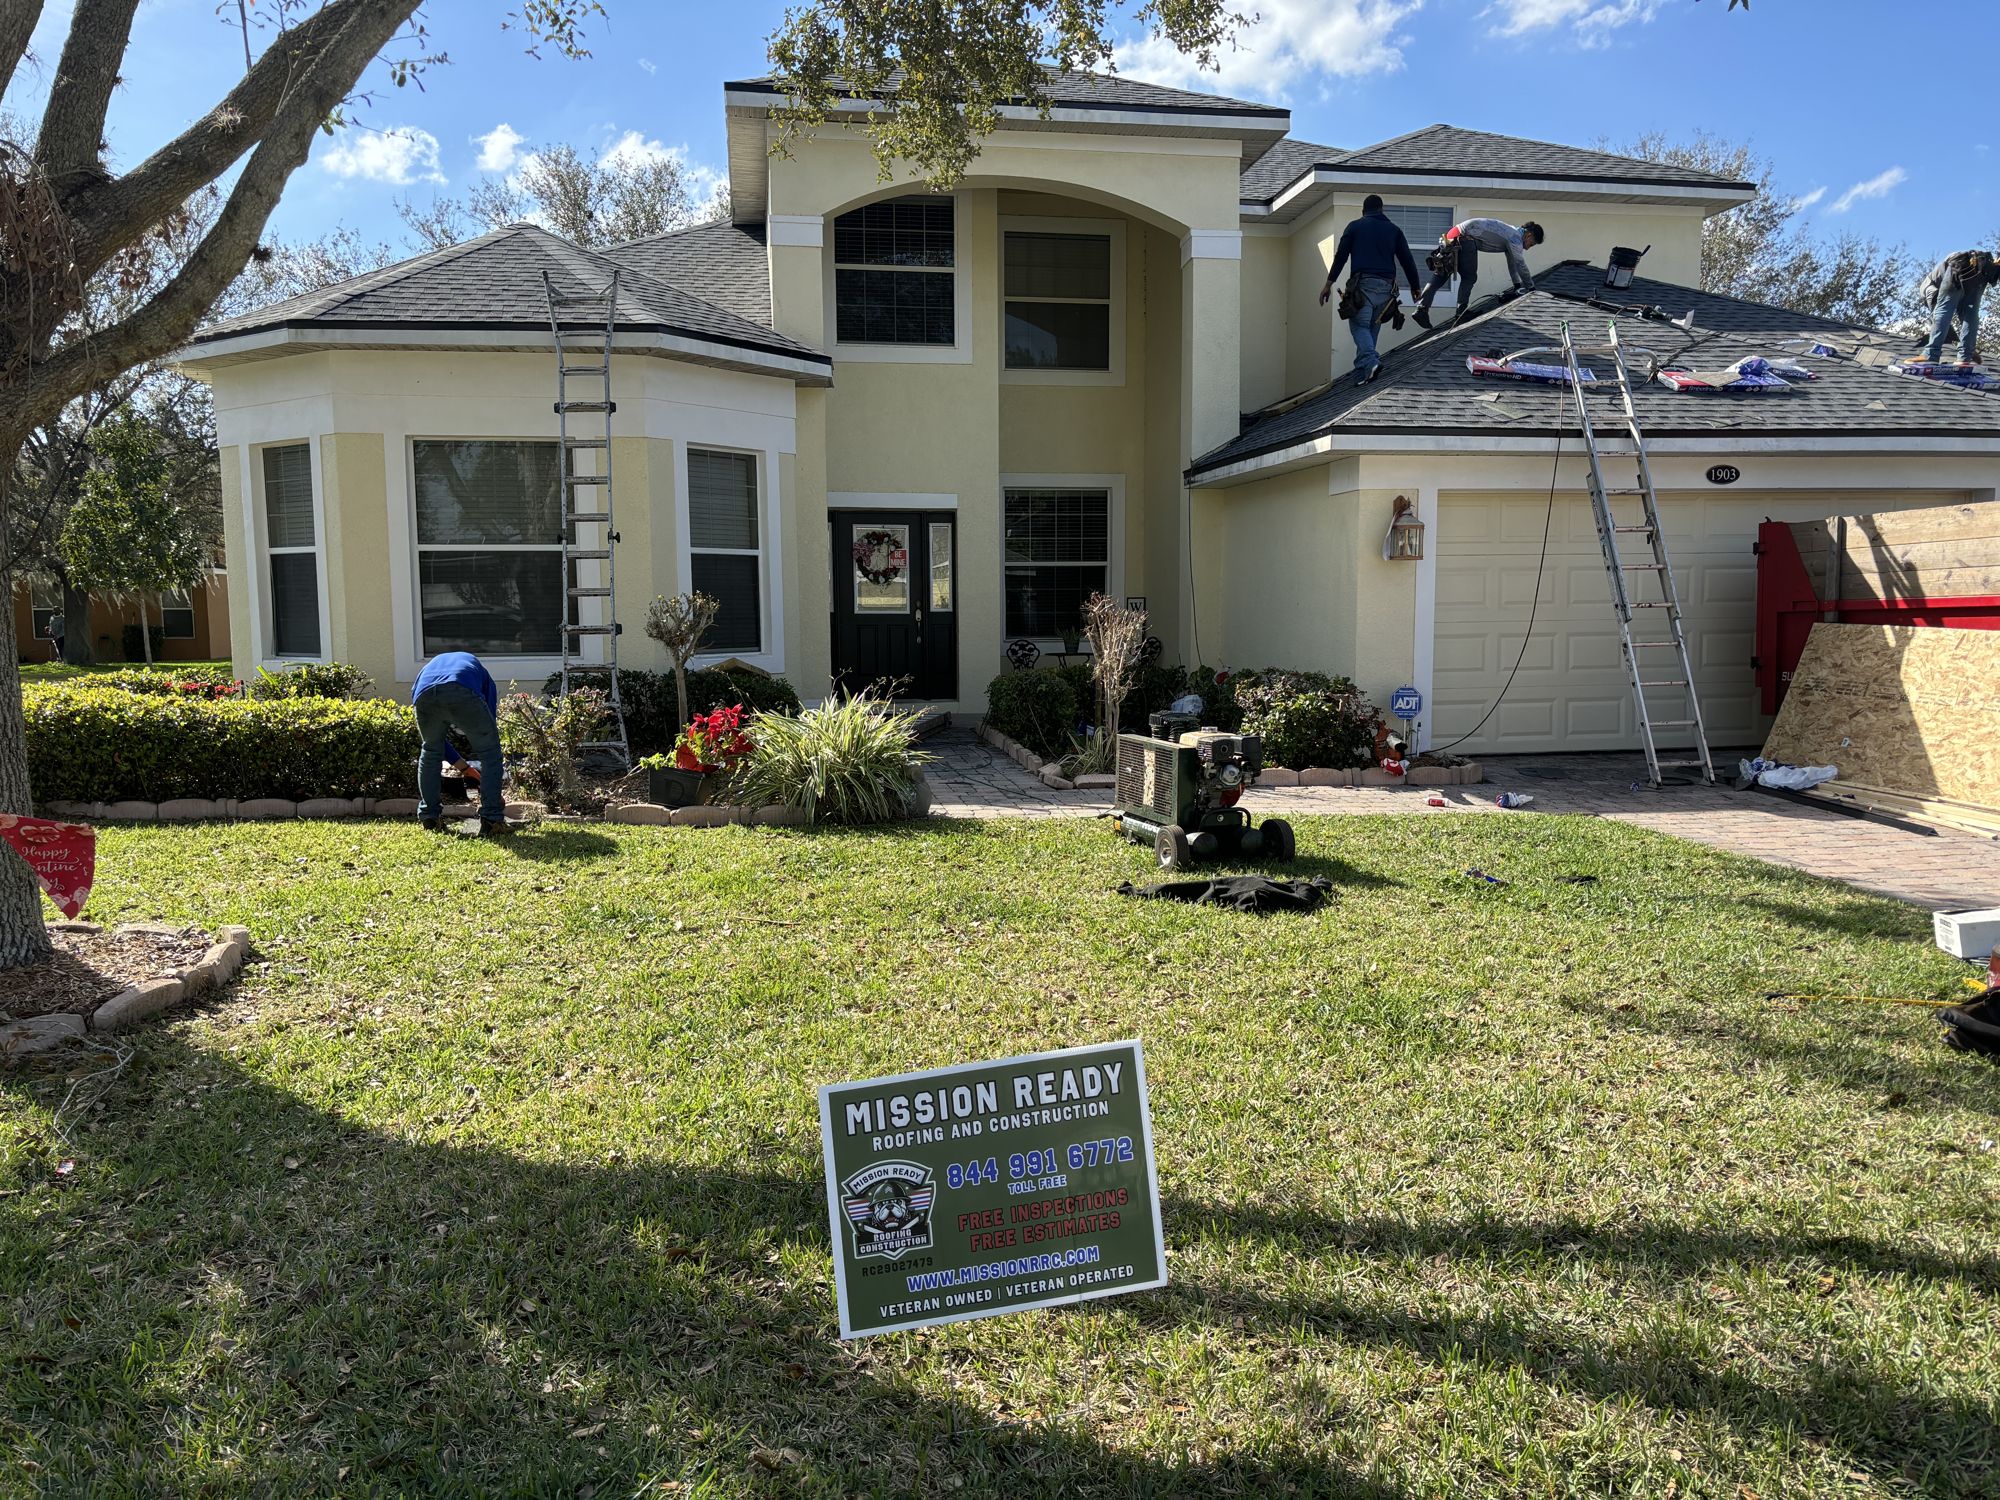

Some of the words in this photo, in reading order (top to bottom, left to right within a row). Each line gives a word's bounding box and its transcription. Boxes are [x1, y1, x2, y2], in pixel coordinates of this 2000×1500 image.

[1711, 468, 1736, 480] 1903
[890, 558, 906, 567] MINE
[894, 550, 903, 559] BE
[1395, 696, 1419, 710] ADT
[21, 846, 71, 861] Happy
[845, 1080, 998, 1136] MISSION
[1013, 1062, 1123, 1110] READY
[872, 1126, 944, 1152] ROOFING
[951, 1119, 983, 1139] AND
[989, 1100, 1110, 1132] CONSTRUCTION
[947, 1157, 998, 1190] 844
[1009, 1148, 1058, 1179] 991
[1067, 1136, 1134, 1170] 6772
[853, 1167, 889, 1190] MISSION
[892, 1167, 922, 1180] READY
[1008, 1179, 1036, 1195] TOLL
[1038, 1174, 1067, 1190] FREE
[958, 1207, 1004, 1232] FREE
[1010, 1187, 1129, 1224] INSPECTIONS
[873, 1228, 912, 1242] ROOFING
[970, 1228, 1017, 1252] FREE
[1023, 1211, 1121, 1244] ESTIMATES
[860, 1235, 927, 1254] CONSTRUCTION
[862, 1257, 933, 1277] RC29027479
[906, 1246, 1100, 1293] WWW.MISSIONRRC.COM
[879, 1300, 941, 1319] VETERAN
[945, 1289, 993, 1308] OWNED
[1006, 1279, 1066, 1298] VETERAN
[1069, 1265, 1135, 1286] OPERATED
